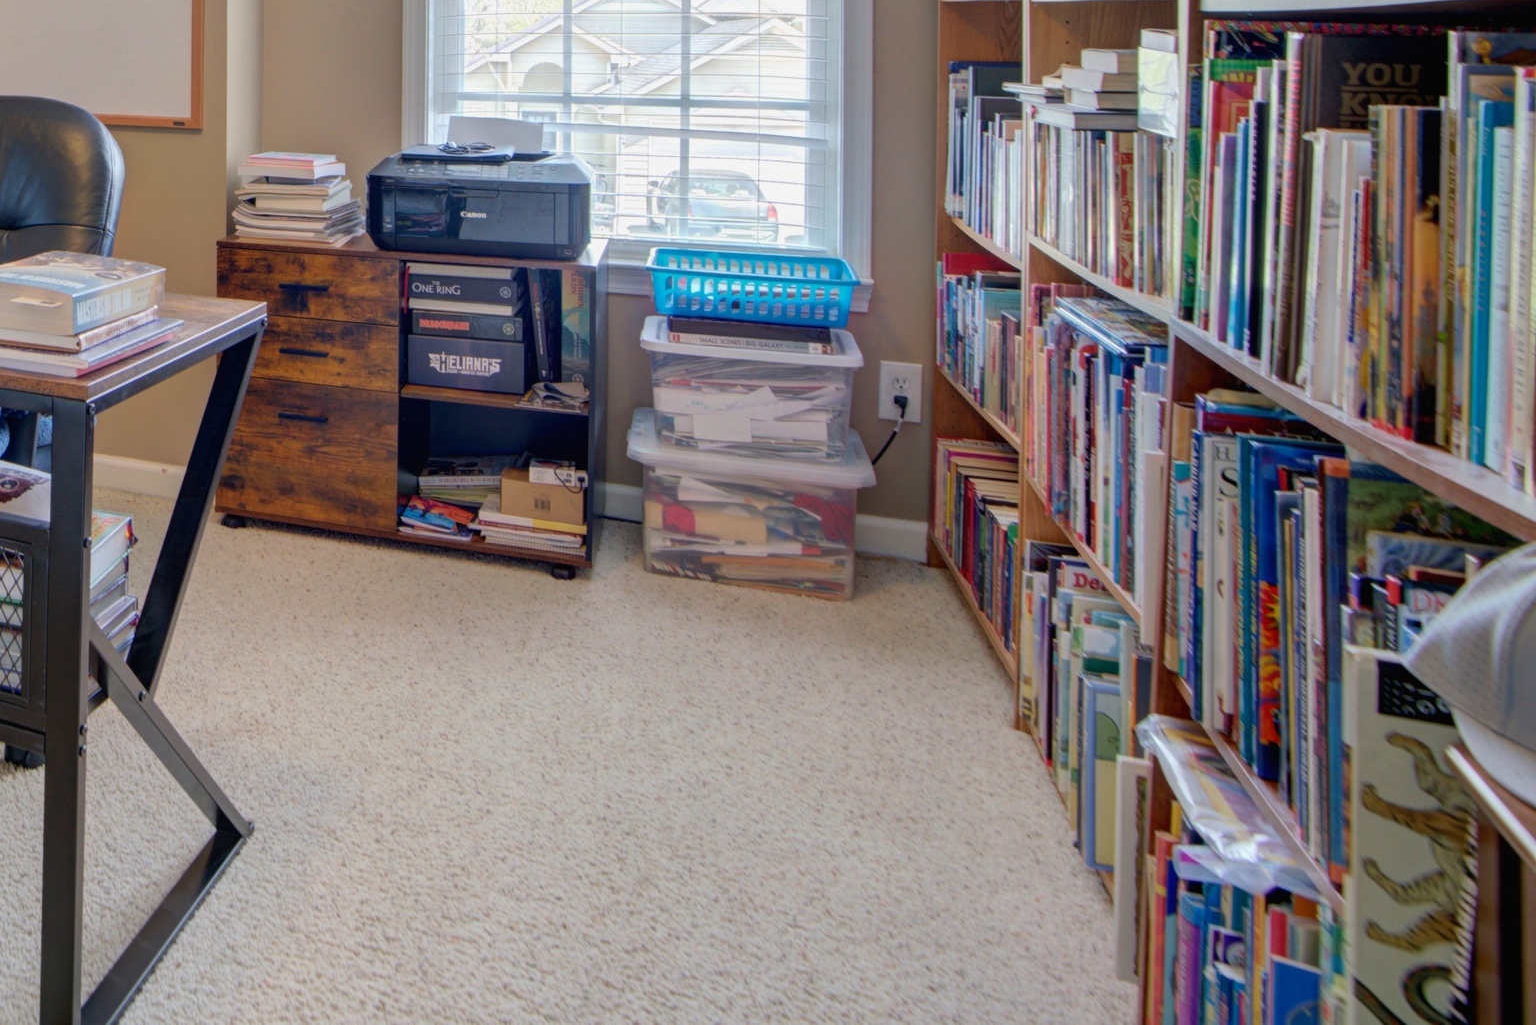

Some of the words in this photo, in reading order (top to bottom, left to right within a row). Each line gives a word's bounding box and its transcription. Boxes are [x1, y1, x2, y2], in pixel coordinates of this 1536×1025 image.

[1342, 62, 1422, 87] YOU
[459, 210, 487, 220] Canon
[411, 281, 433, 295] ONE
[434, 283, 461, 296] RING
[698, 335, 719, 346] SMALL
[720, 337, 741, 347] SCENES
